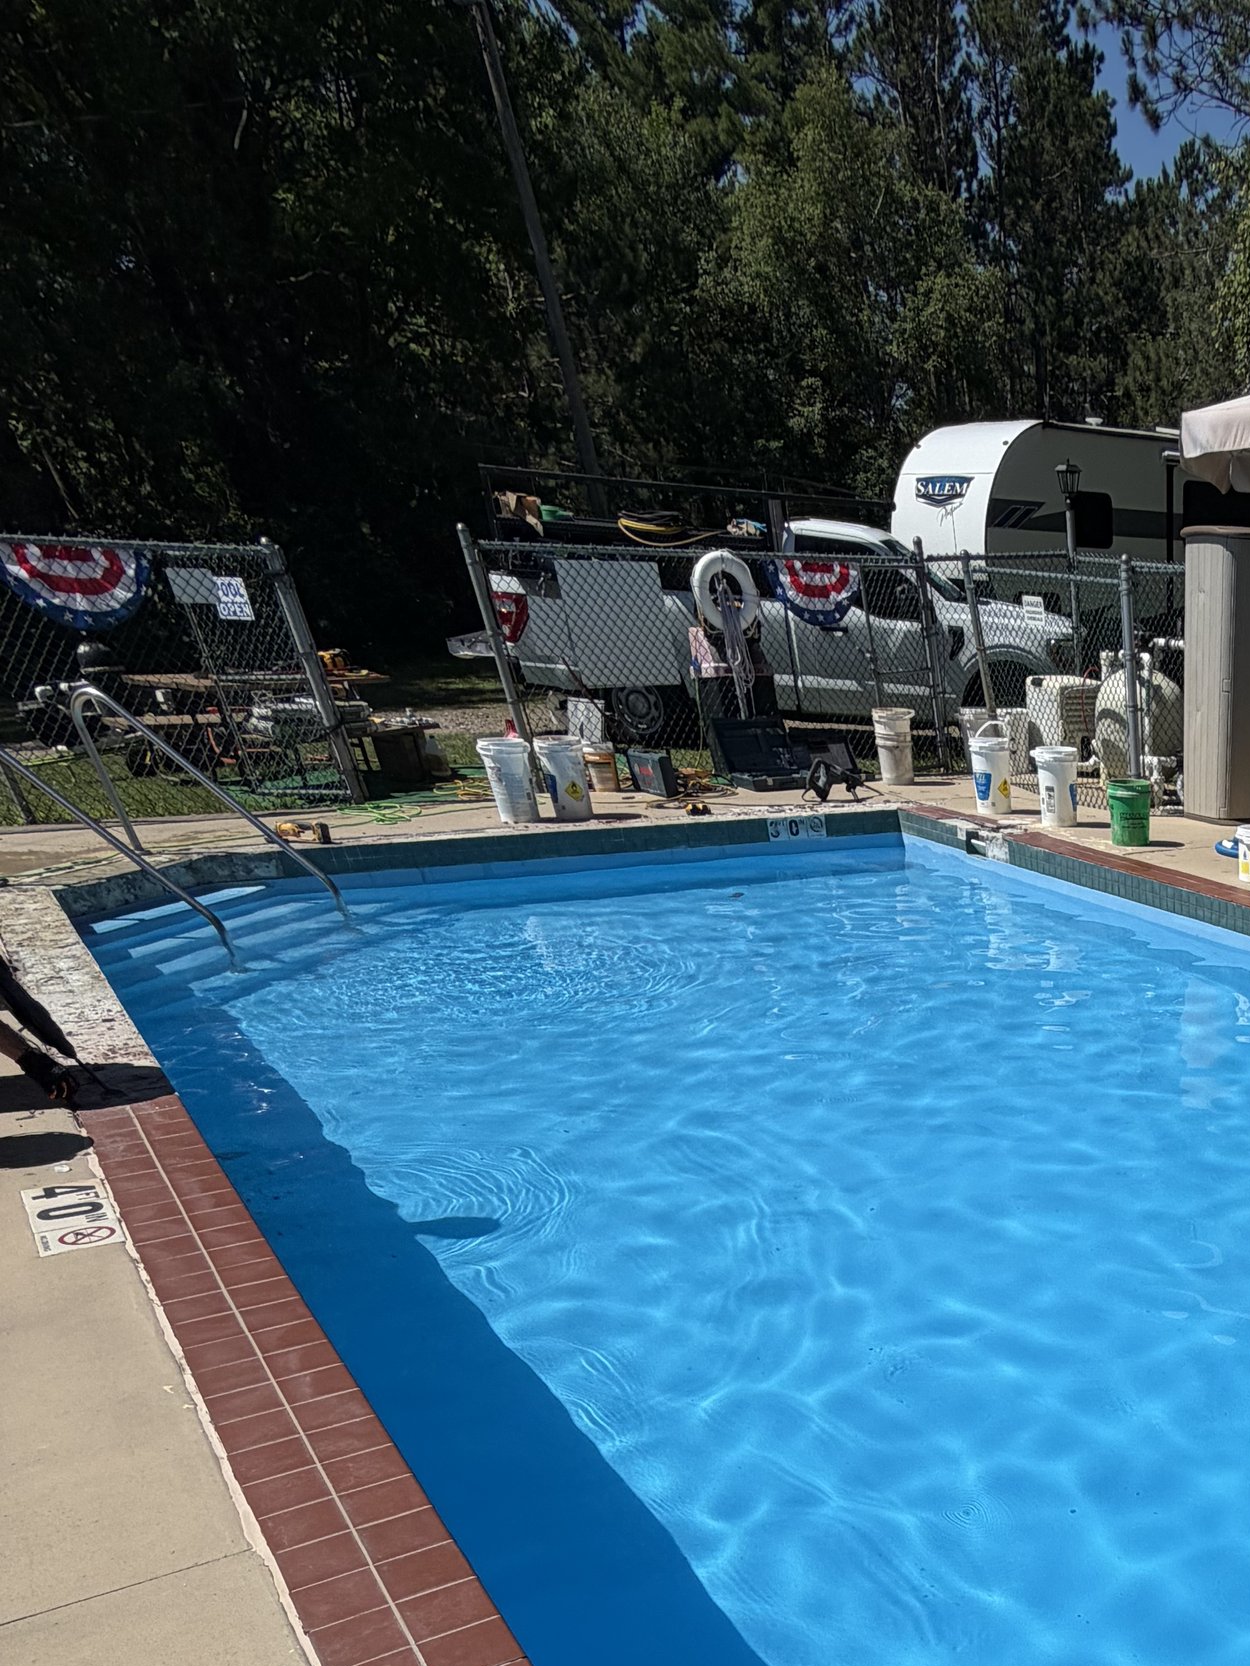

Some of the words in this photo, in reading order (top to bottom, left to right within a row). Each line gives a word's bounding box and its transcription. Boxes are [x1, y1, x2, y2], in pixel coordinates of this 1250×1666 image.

[916, 481, 968, 495] SALEM
[219, 602, 252, 618] OPEN
[788, 819, 800, 836] 0
[31, 1185, 97, 1200] 4
[36, 1201, 104, 1221] 0
